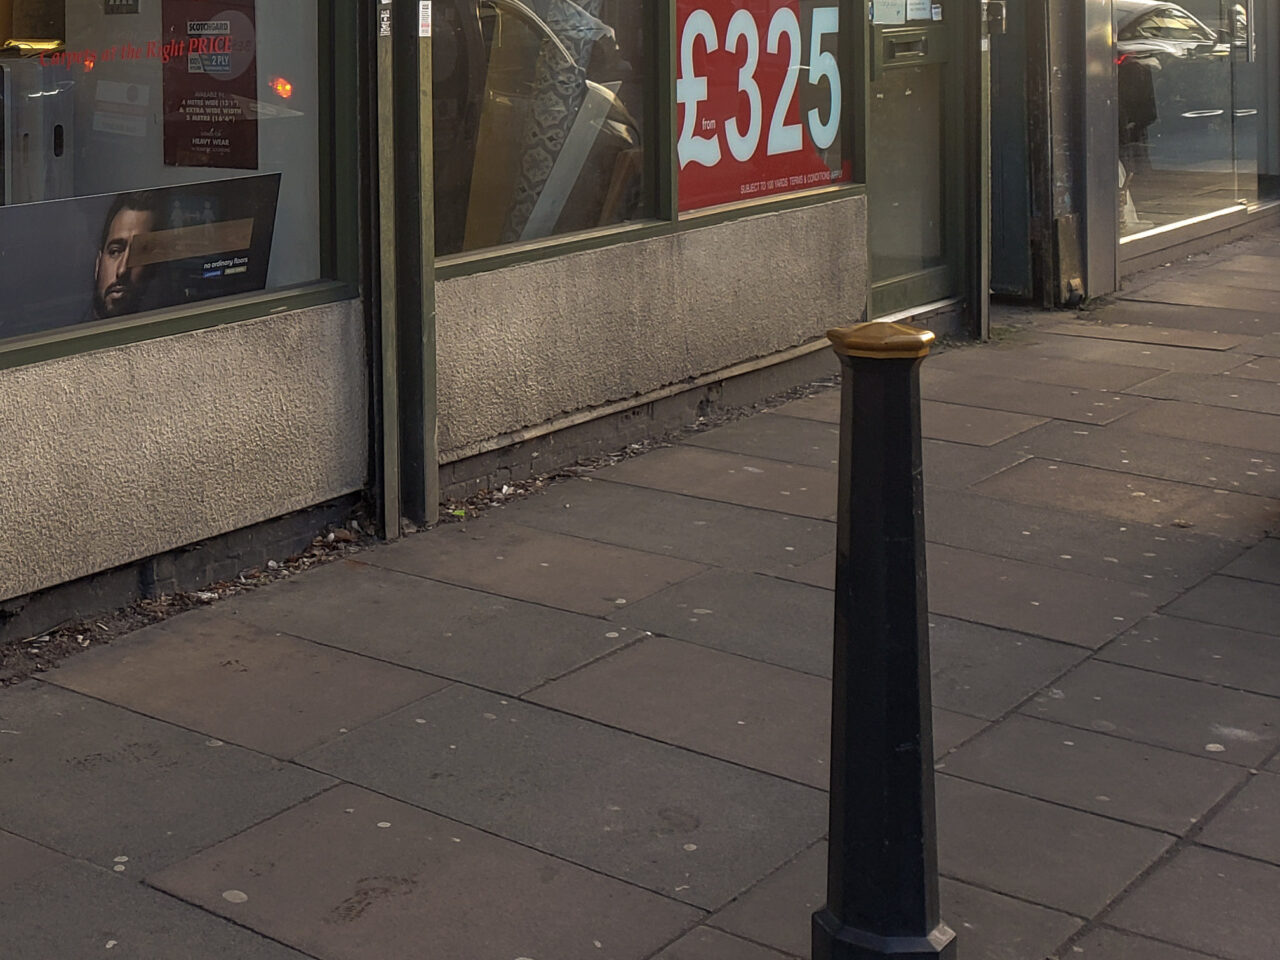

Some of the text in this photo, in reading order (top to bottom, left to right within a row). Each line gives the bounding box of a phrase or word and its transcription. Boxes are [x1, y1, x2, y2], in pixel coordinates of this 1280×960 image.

[40, 48, 98, 71] Carpets
[101, 44, 119, 63] at
[121, 42, 143, 62] the
[146, 38, 186, 64] Right
[188, 35, 234, 56] PRICE
[211, 55, 217, 66] 2
[217, 54, 230, 66] PLY
[676, 6, 842, 169] £325
[222, 107, 242, 115] WIDTH
[702, 117, 716, 131] from
[192, 137, 230, 146] HEAVY WEAR
[740, 181, 761, 194] SUBJECT
[760, 181, 767, 191] TO
[775, 178, 788, 189] YARDS
[789, 175, 804, 187] TERMS
[807, 172, 830, 184] CONDITIONS
[211, 259, 234, 268] ordinary
[233, 257, 248, 265] floors
